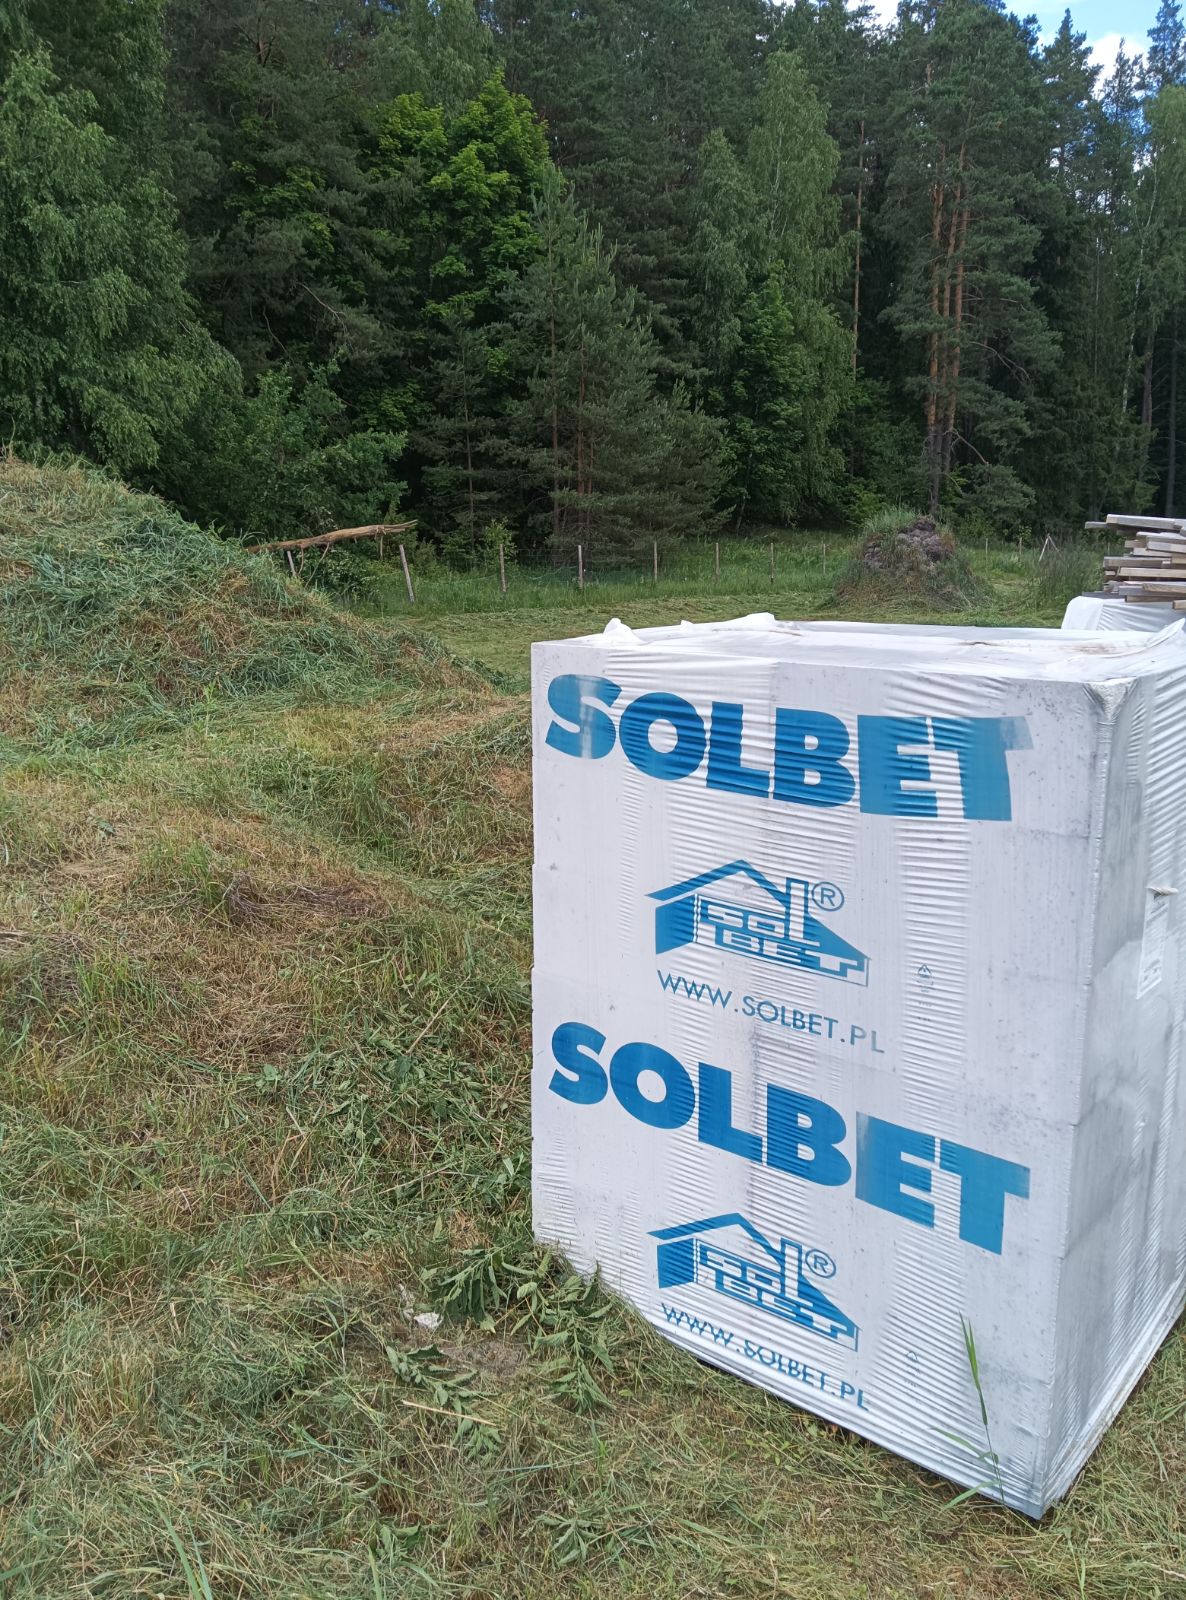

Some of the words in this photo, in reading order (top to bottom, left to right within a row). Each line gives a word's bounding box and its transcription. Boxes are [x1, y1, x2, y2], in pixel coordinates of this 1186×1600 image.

[545, 673, 1034, 821] SOLBET
[657, 968, 885, 1054] WWW.SOLBET.PL
[548, 1022, 1030, 1255] SOLBET
[661, 1302, 870, 1412] WWW.SOLBET.PL
